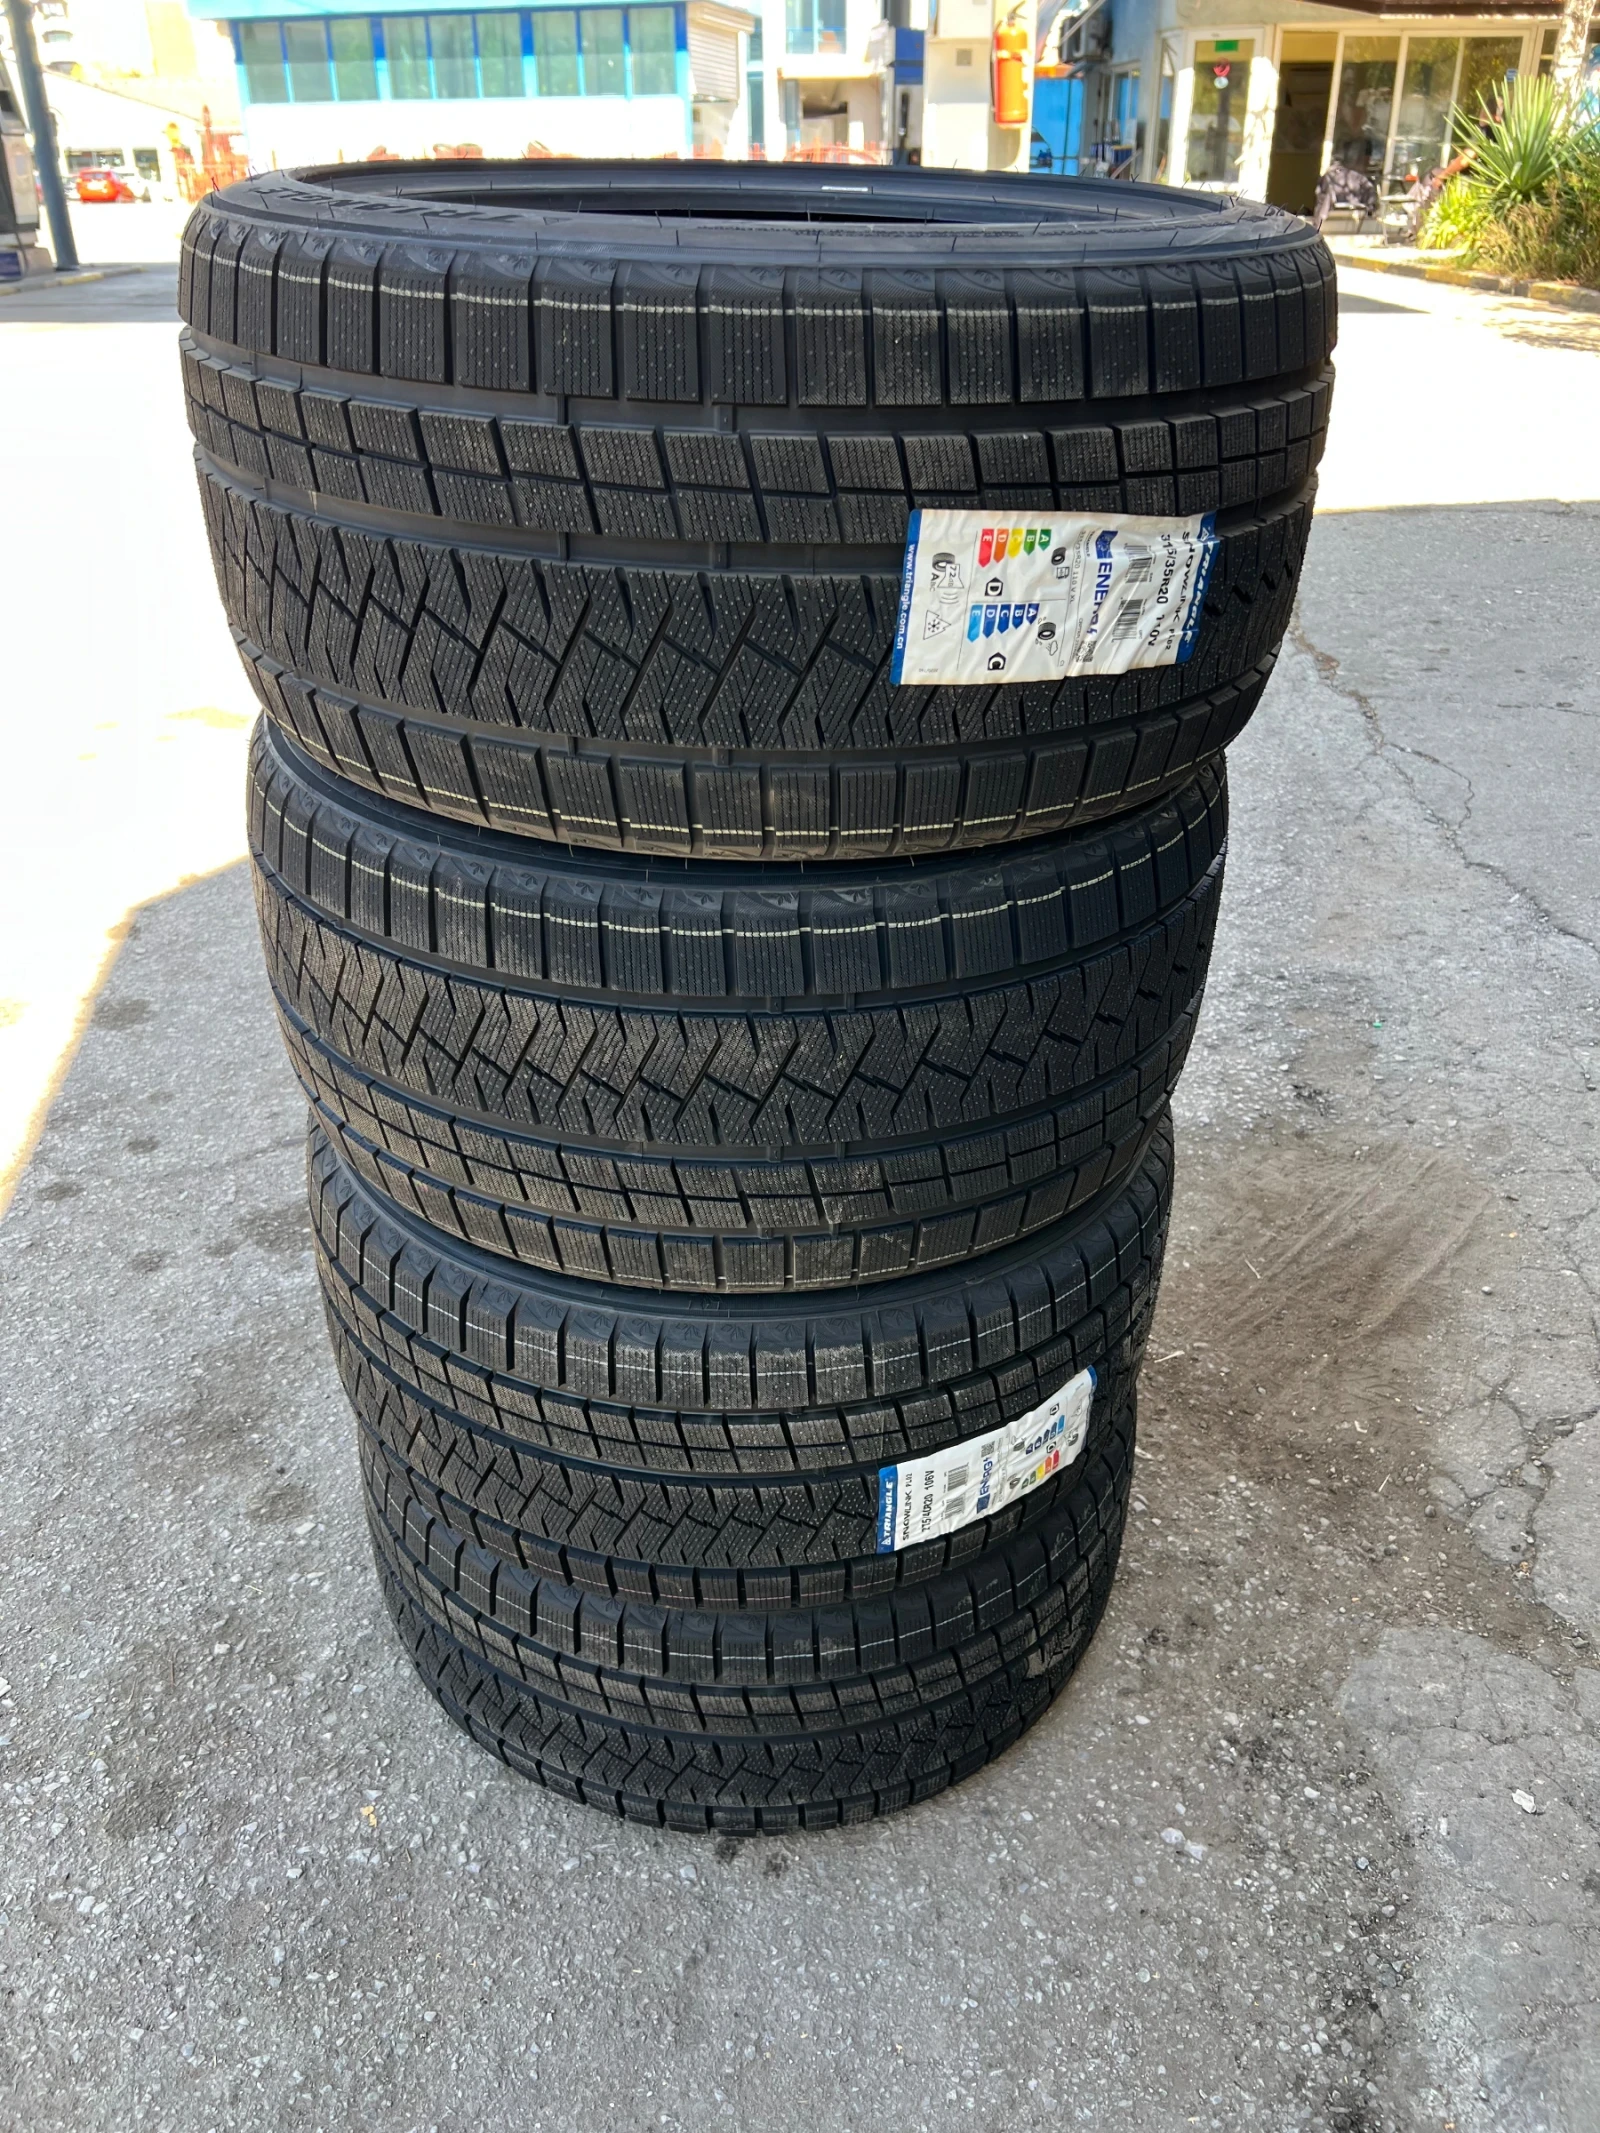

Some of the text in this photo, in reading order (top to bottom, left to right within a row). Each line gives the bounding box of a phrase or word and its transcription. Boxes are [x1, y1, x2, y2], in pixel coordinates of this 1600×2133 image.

[983, 534, 993, 542] E
[998, 534, 1008, 543] D
[1012, 534, 1021, 542] C
[1026, 534, 1035, 542] B
[1040, 533, 1050, 543] A
[1172, 531, 1196, 624] SNOWLINK
[987, 581, 1001, 596] D
[1148, 533, 1178, 647] 315/35R20 110V
[1183, 541, 1215, 644] TRIANGLE
[896, 543, 917, 650] www.triangle.com.cn
[972, 609, 981, 617] E
[986, 609, 995, 618] D
[1000, 609, 1009, 618] C
[1014, 609, 1023, 617] B
[1027, 607, 1037, 618] A
[988, 655, 1004, 671] C
[924, 1469, 935, 1491] 106V
[884, 1480, 895, 1538] TRIANGLE
[902, 1489, 913, 1541] SNOWLINK
